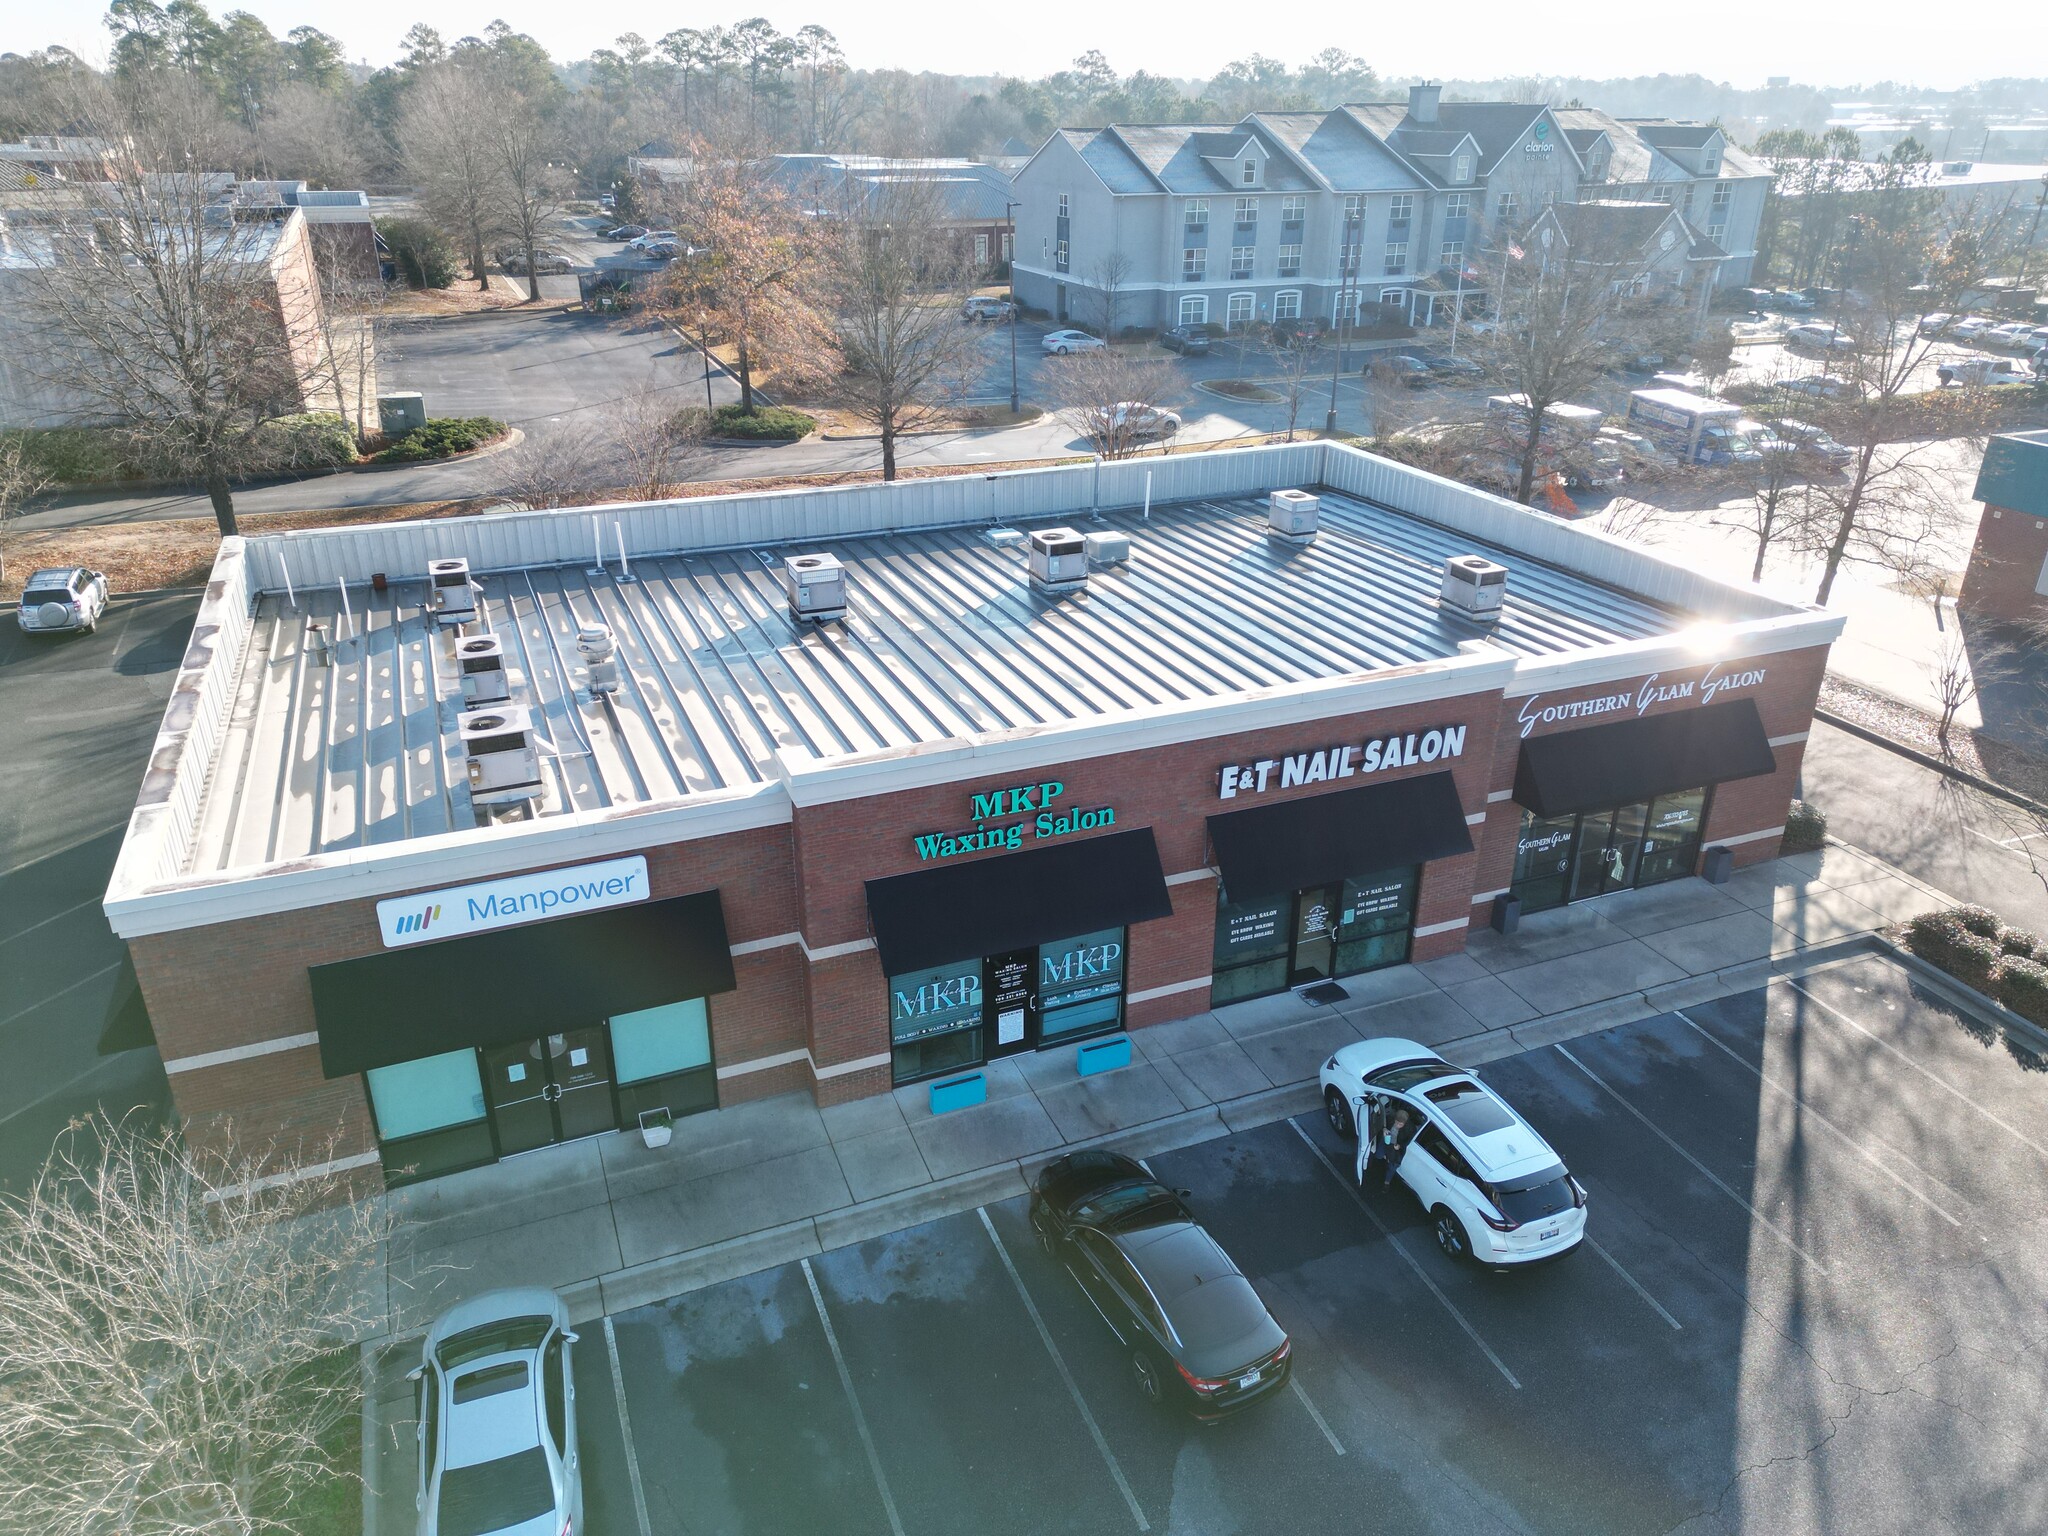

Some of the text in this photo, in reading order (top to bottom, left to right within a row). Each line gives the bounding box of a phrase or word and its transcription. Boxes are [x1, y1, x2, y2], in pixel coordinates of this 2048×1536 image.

[1525, 141, 1554, 152] clarion
[1219, 725, 1466, 799] E&T NAIL SALON
[971, 782, 1064, 821] MKP
[914, 805, 1115, 861] Waxing Salon
[467, 872, 635, 922] Manpower
[1042, 943, 1120, 984] MKP
[894, 975, 979, 1020] MKP
